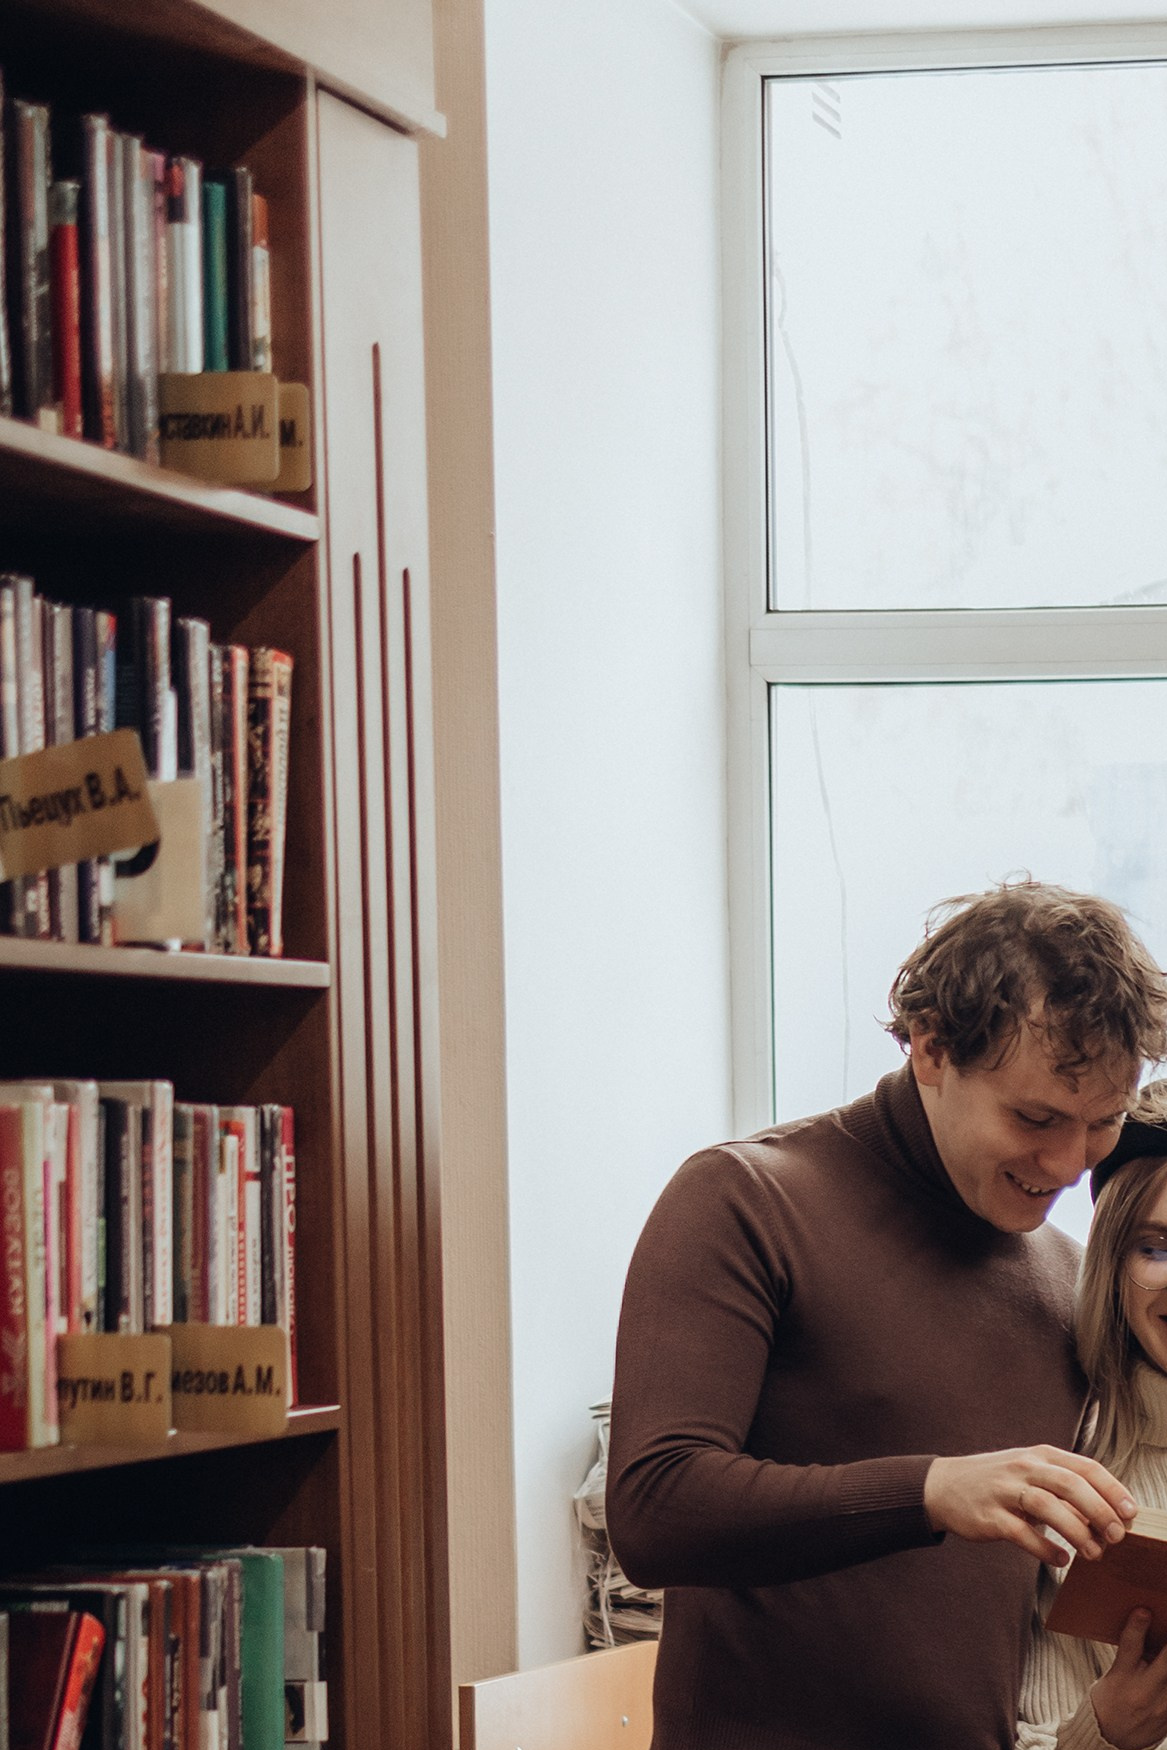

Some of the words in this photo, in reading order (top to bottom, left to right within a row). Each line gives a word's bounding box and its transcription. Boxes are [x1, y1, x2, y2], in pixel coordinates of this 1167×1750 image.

[85, 768, 142, 810] В.А.
[120, 1370, 164, 1403] В.Г.
[231, 1364, 283, 1397] А.М.
